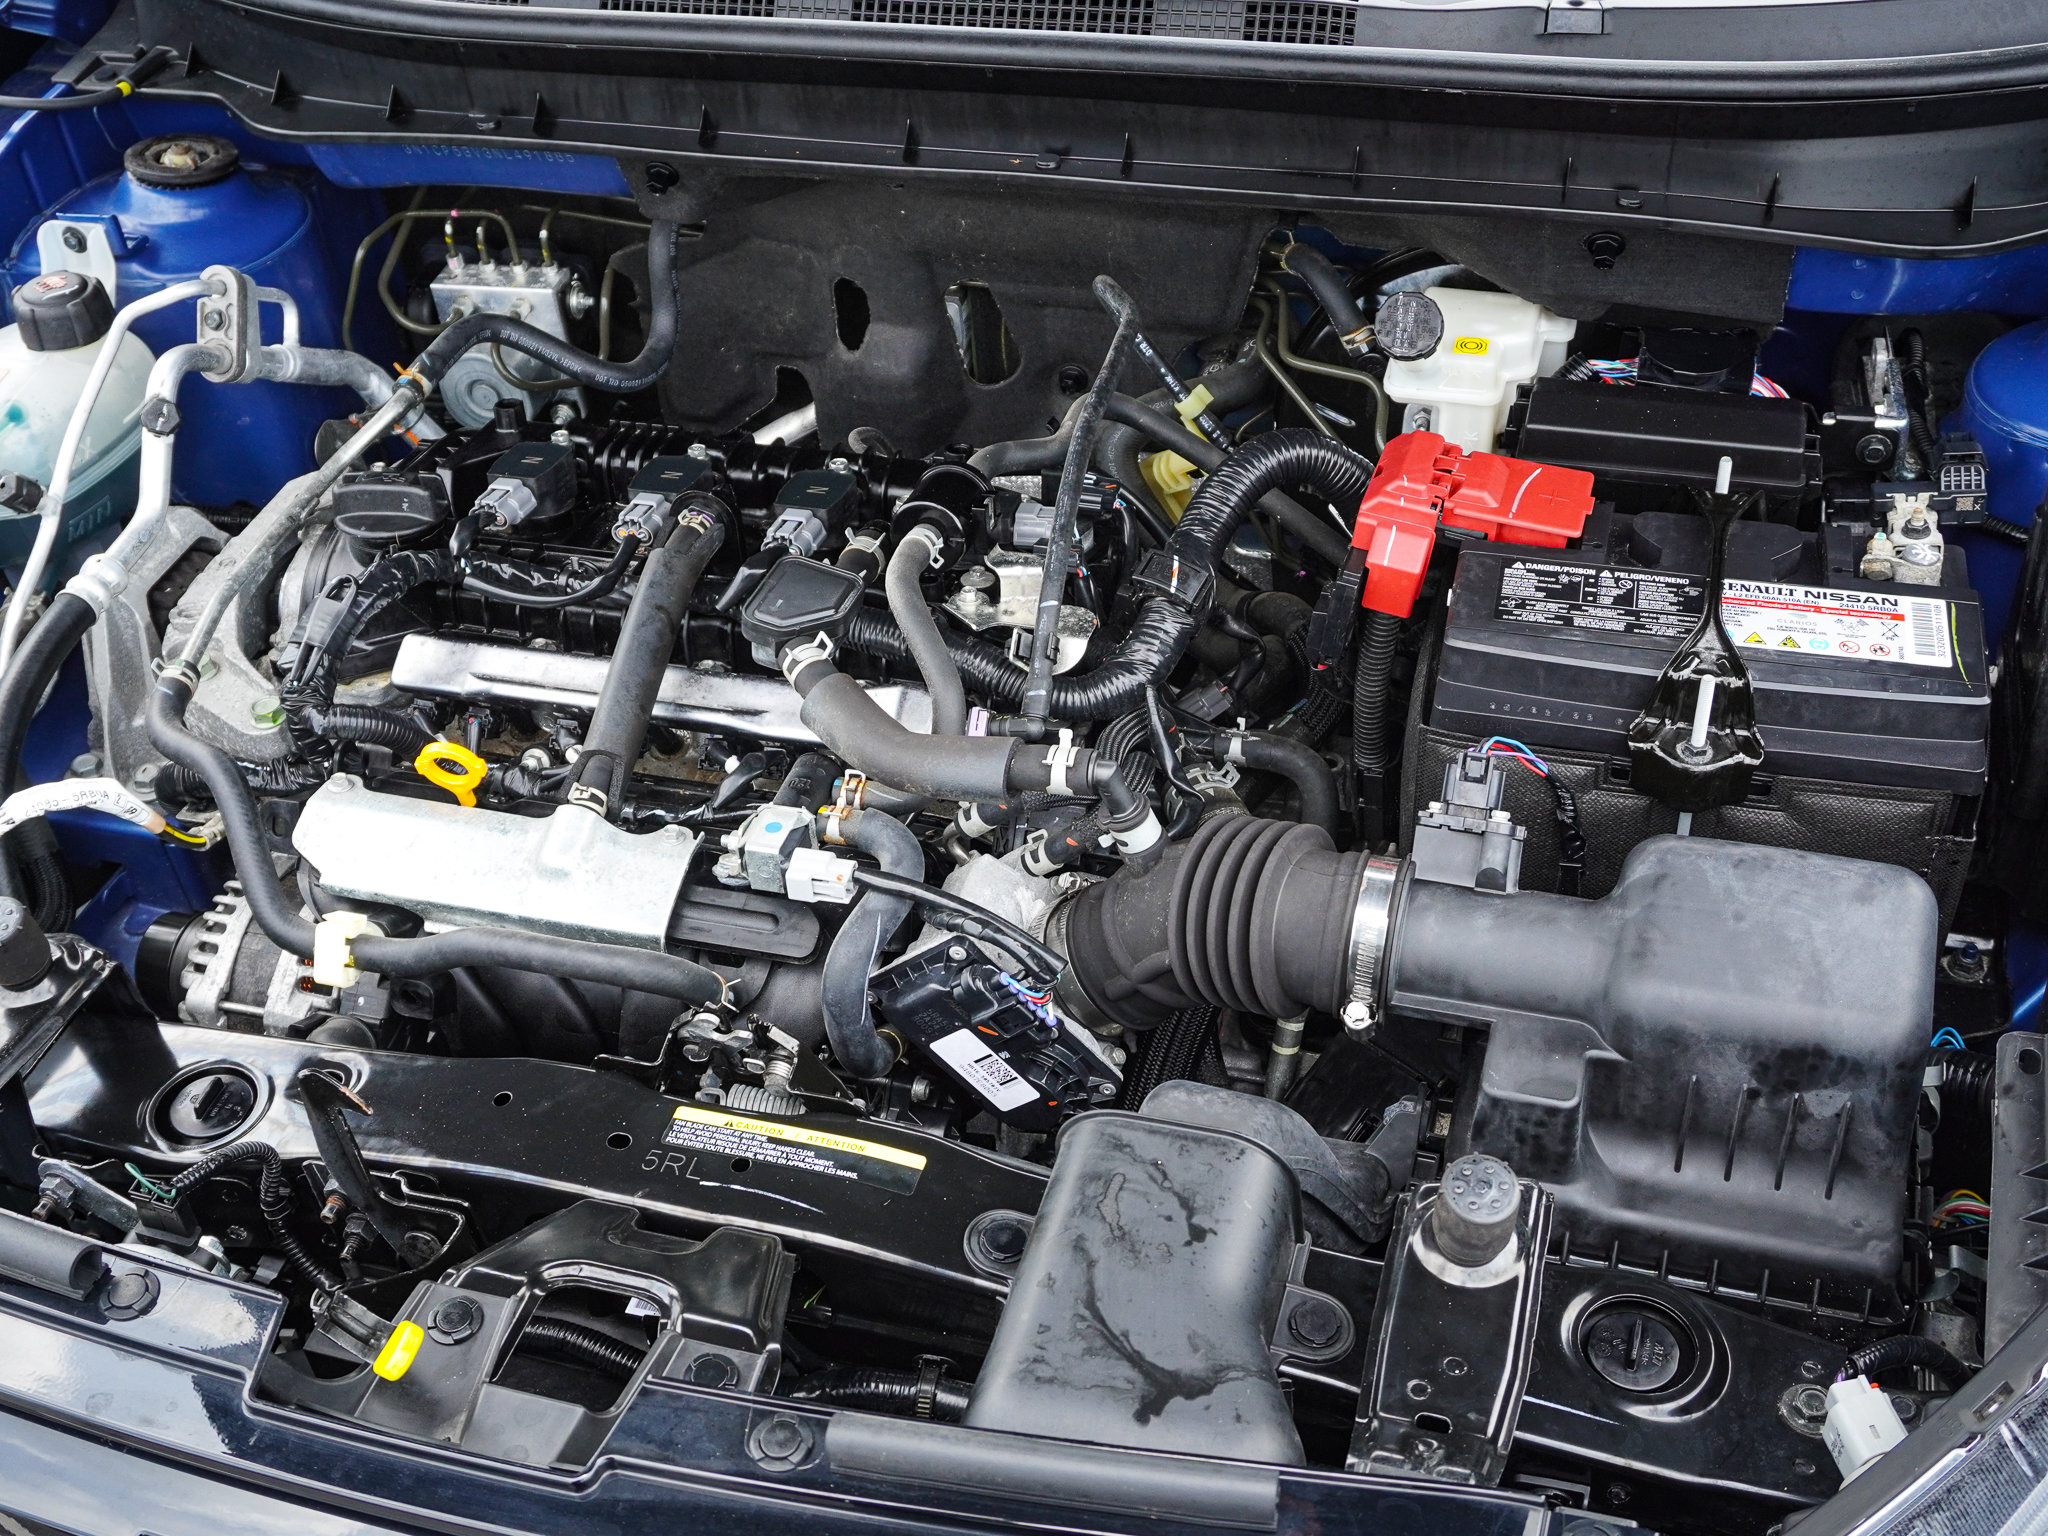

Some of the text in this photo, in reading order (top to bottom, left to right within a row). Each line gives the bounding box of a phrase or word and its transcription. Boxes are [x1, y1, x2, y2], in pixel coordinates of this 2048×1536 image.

[1525, 562, 1597, 575] DANGER/POISON
[1614, 571, 1690, 585] PELIGRO/VENENO
[1722, 597, 1756, 606] Enhanced
[1756, 600, 1787, 609] Flooded
[1788, 604, 1815, 612] Battery
[1820, 607, 1849, 615] Special
[1849, 610, 1893, 620] technology
[1804, 590, 1898, 607] NISSAN
[1839, 602, 1866, 610] 24410
[1777, 618, 1818, 626] CLARIOS
[674, 1119, 686, 1127] FAN
[686, 1121, 704, 1130] BLADE
[704, 1124, 717, 1132] CAN
[717, 1126, 734, 1135] START
[741, 1131, 754, 1139] ANY
[735, 1121, 784, 1136] CAUTION
[806, 1135, 866, 1152] ATTENTION
[677, 1132, 716, 1145] VENTILATEUR
[716, 1139, 738, 1149] RISQUE
[738, 1142, 748, 1150] DE
[788, 1153, 804, 1161] TOUT
[804, 1156, 834, 1168] MOMENT.
[680, 1126, 695, 1135] HELP
[695, 1129, 712, 1138] AVOID
[712, 1132, 741, 1144] PERSONAL
[762, 1141, 776, 1149] KEEP
[776, 1143, 796, 1154] HANDS
[796, 1148, 815, 1157] CLEAR.
[641, 1149, 701, 1180] 5RL
[666, 1136, 683, 1145] POUR
[705, 1143, 725, 1152] TOUTE
[756, 1153, 765, 1161] NE
[765, 1155, 778, 1163] PAS
[777, 1157, 787, 1165] EN
[787, 1159, 825, 1173] APPROCHER
[824, 1166, 836, 1175] LES
[836, 1169, 858, 1180] MAINS.
